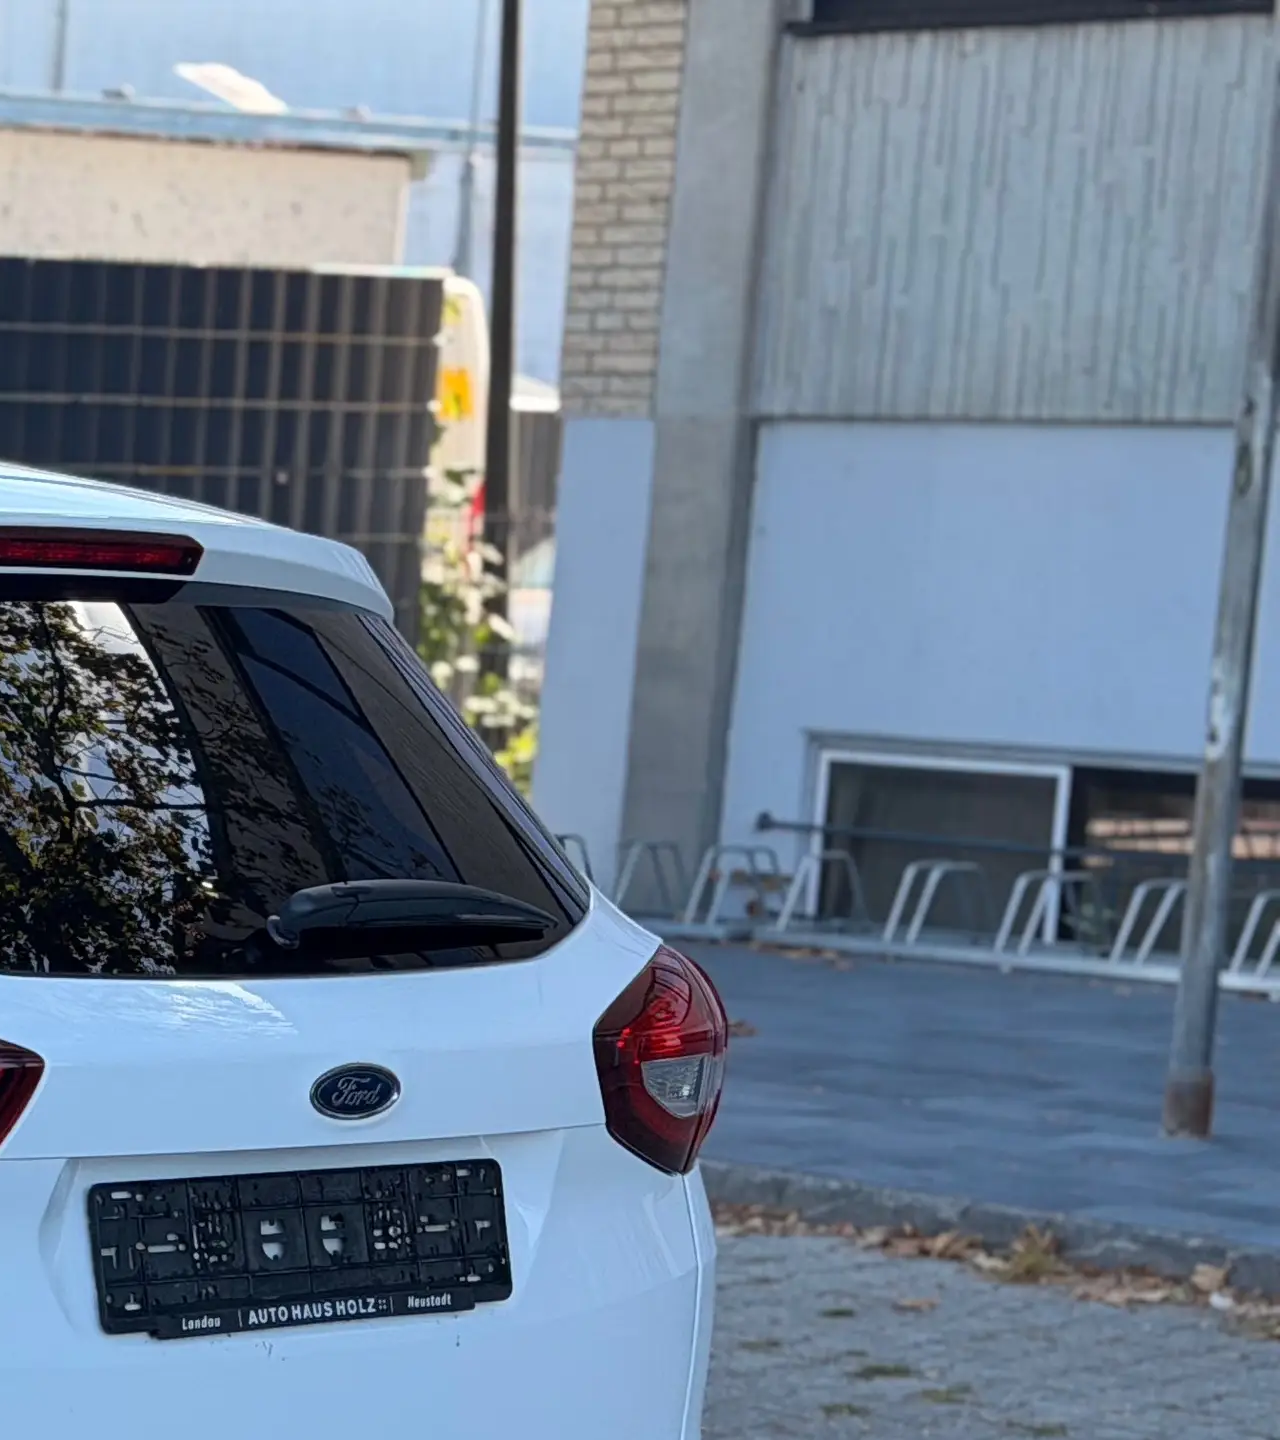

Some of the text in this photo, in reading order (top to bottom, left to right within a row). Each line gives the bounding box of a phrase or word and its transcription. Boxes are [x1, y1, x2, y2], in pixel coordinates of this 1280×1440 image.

[331, 1076, 382, 1107] Ford
[182, 1292, 452, 1331] Landau AUTO HAUS HOLZ Neustadt
